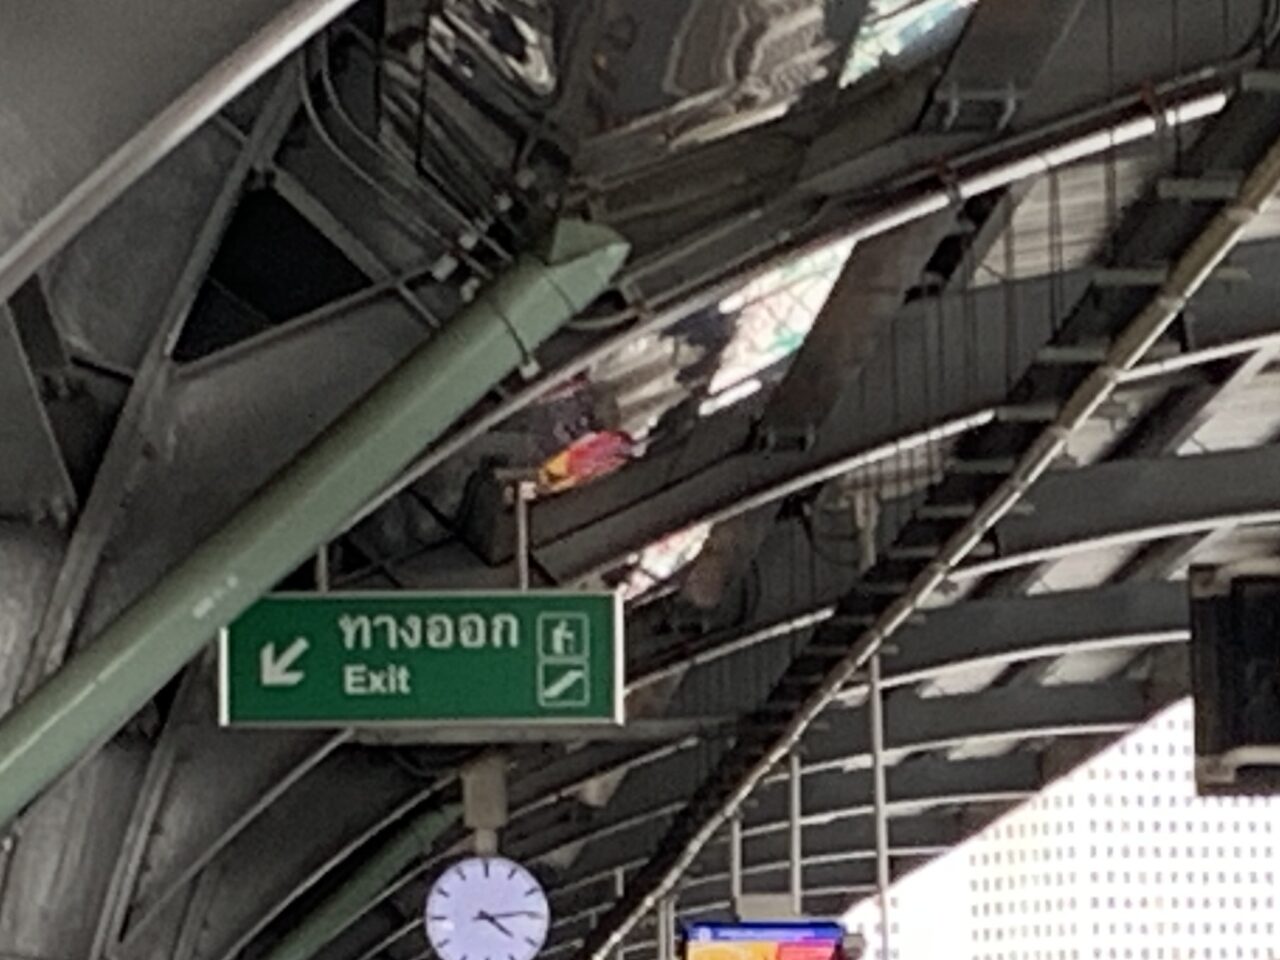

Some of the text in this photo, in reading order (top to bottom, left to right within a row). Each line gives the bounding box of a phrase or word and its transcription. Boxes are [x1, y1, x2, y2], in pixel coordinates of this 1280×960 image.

[338, 613, 519, 649] ทางออก
[344, 664, 411, 695] Exit
